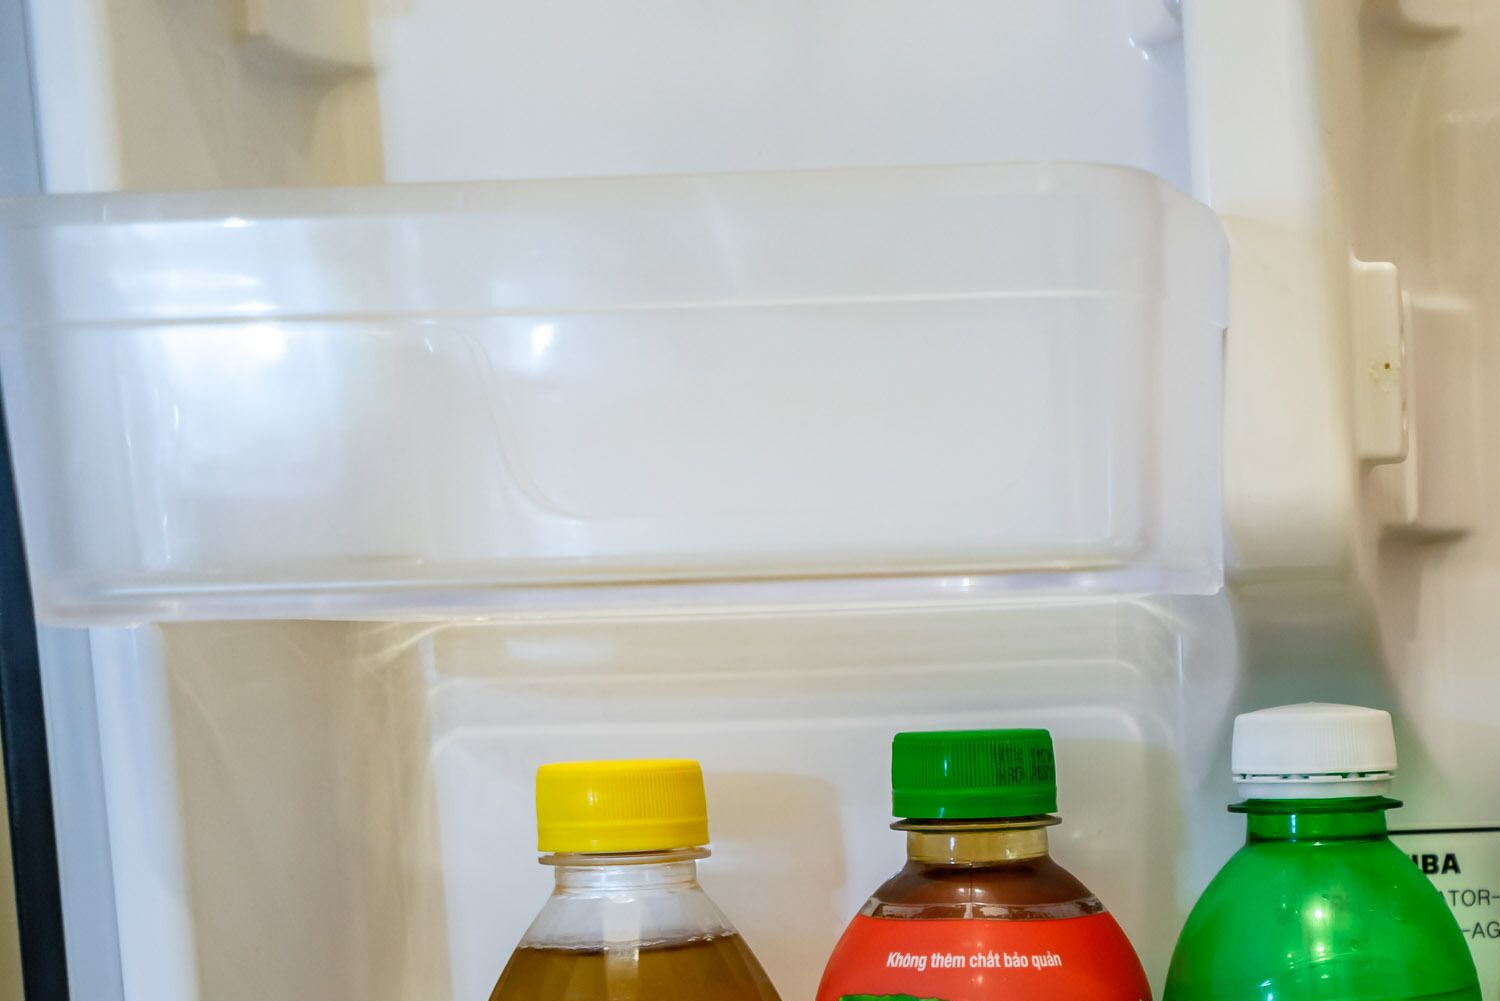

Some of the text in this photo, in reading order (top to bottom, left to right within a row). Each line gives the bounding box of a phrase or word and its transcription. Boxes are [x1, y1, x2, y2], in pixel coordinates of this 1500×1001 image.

[887, 952, 927, 971] Không
[931, 952, 965, 968] thêm
[1004, 952, 1029, 968] bảo
[1031, 951, 1062, 970] quản
